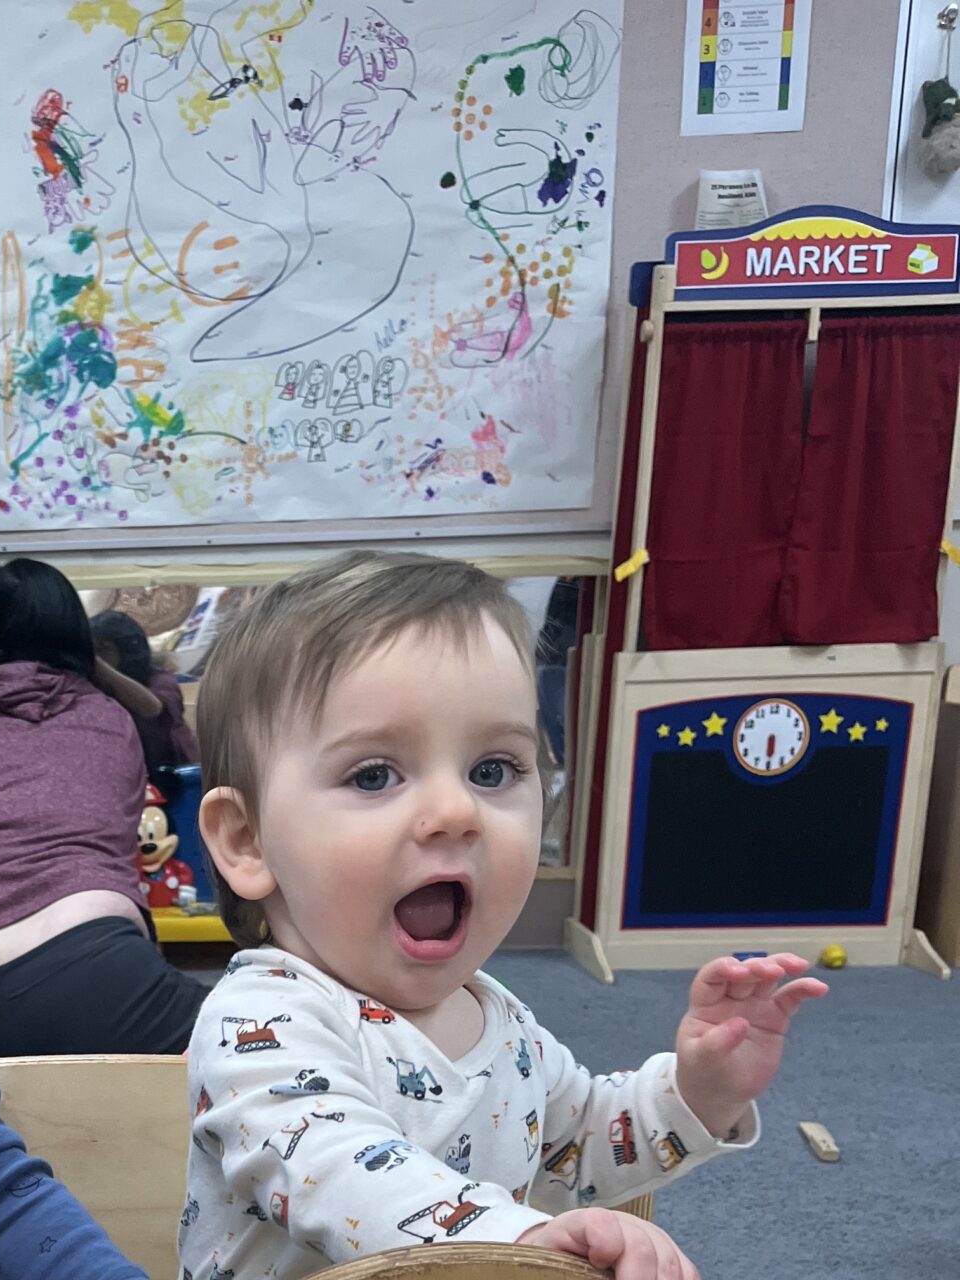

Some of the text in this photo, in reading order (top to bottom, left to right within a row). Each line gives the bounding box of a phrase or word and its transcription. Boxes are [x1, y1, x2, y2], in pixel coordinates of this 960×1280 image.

[703, 44, 710, 55] 3
[745, 243, 892, 277] MARKET
[756, 708, 765, 718] 11
